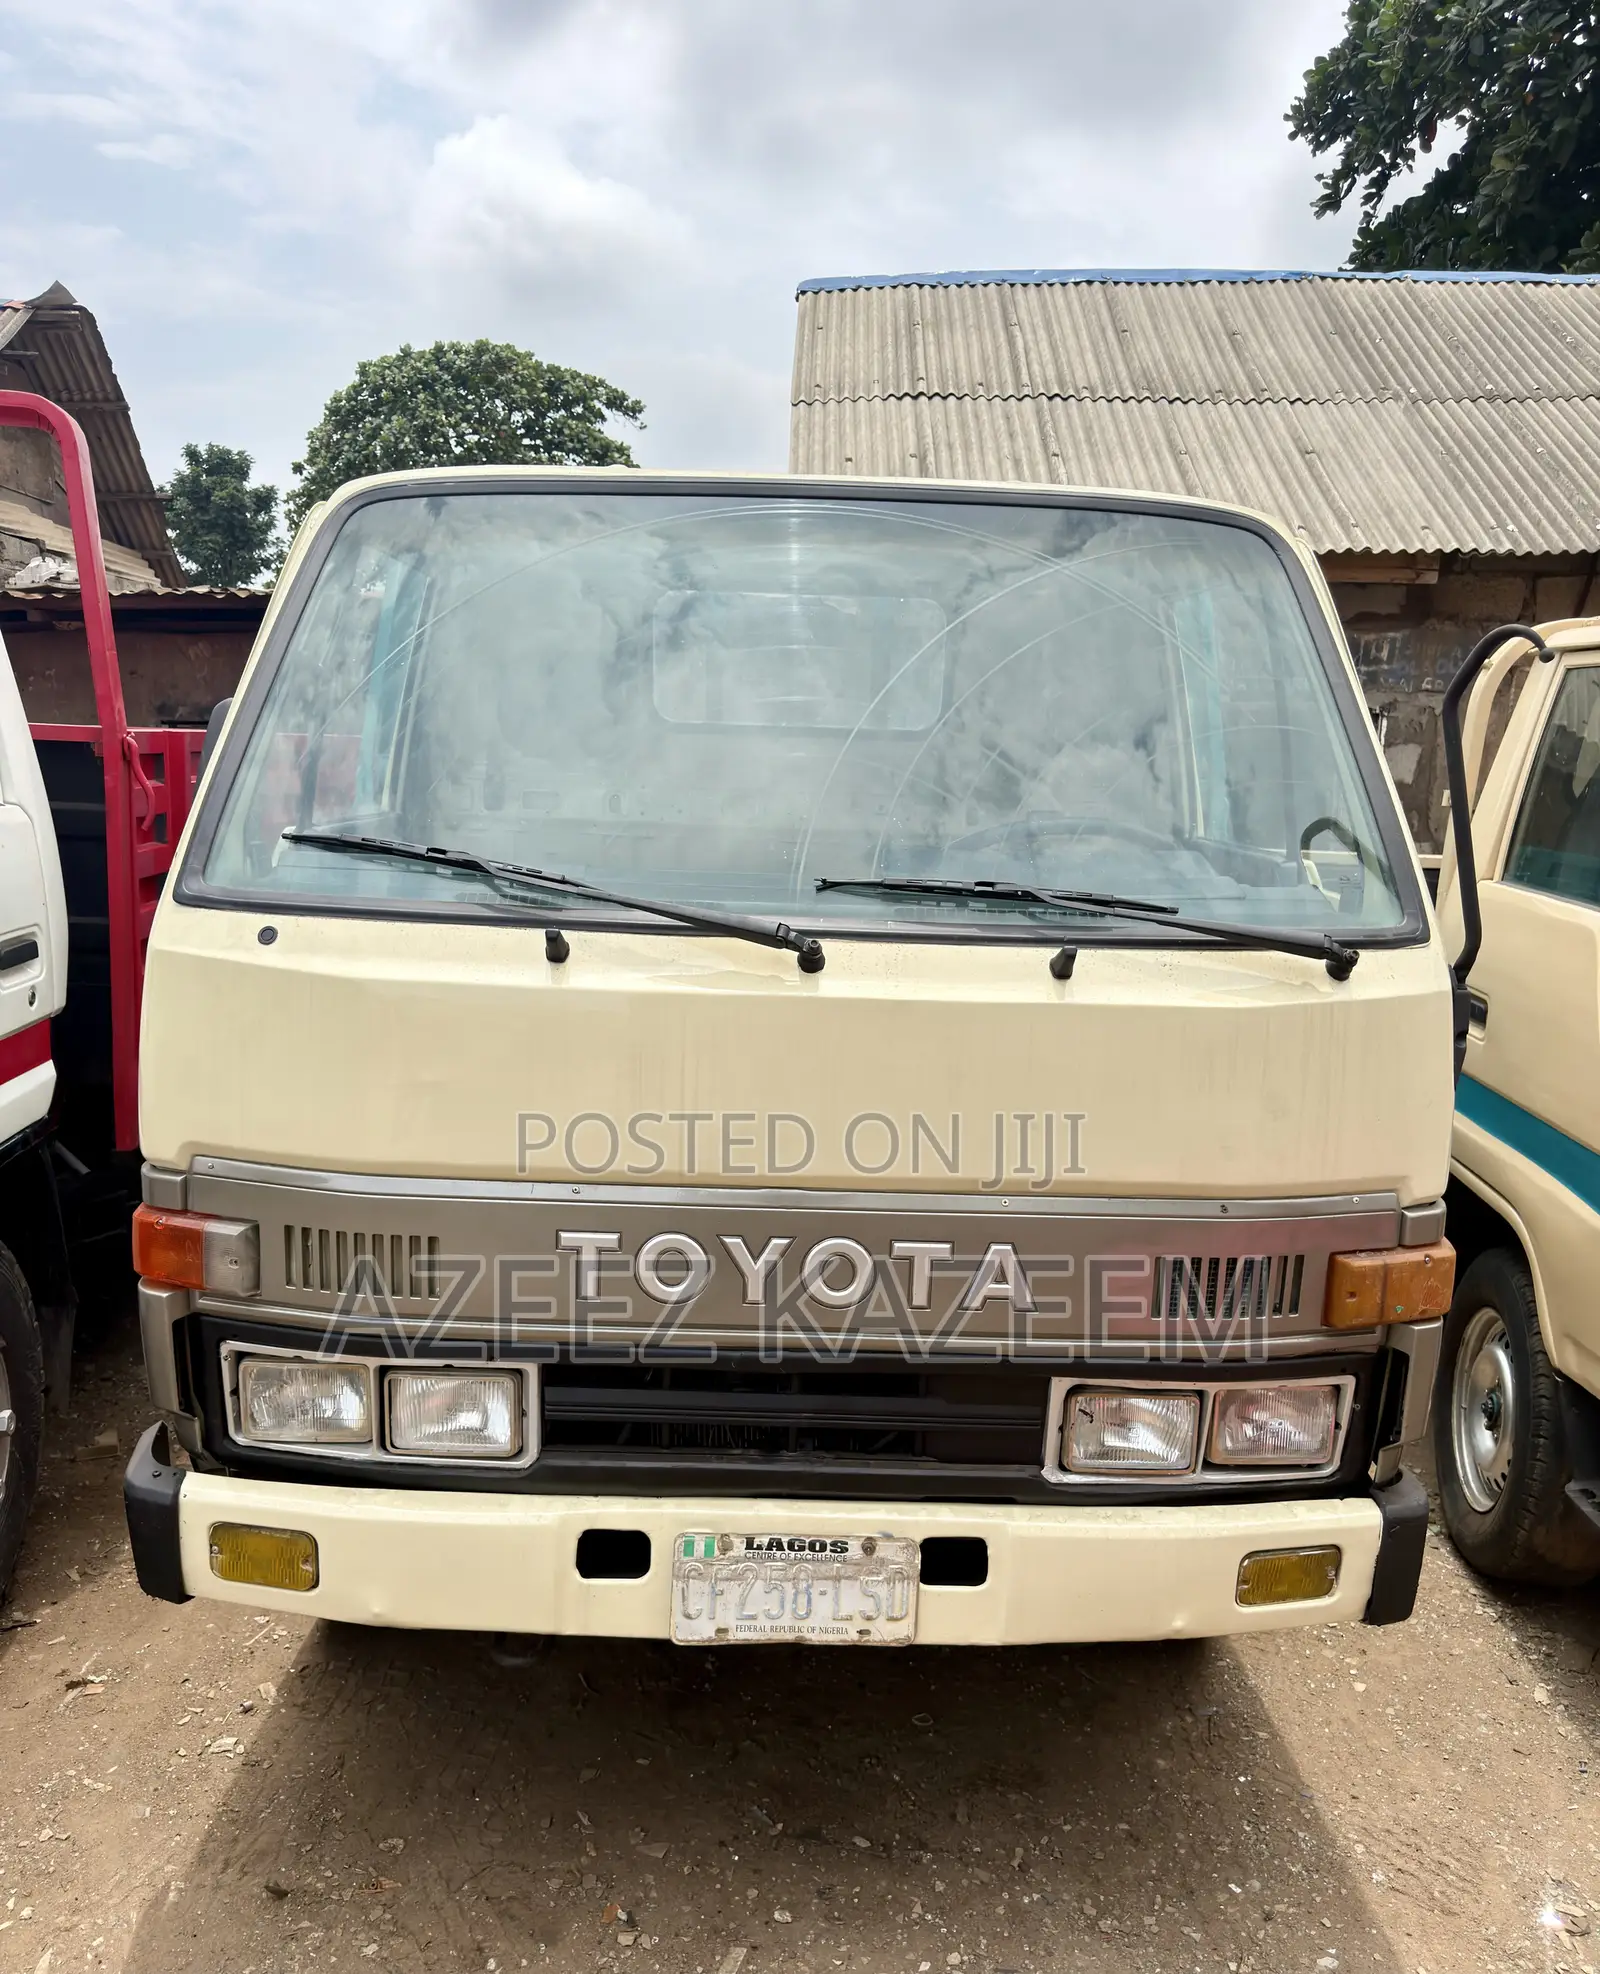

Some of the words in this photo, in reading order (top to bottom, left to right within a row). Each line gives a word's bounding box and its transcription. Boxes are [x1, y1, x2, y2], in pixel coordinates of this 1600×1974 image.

[555, 1228, 1039, 1313] TOYOTA
[744, 1536, 849, 1554] LAGOS
[744, 1551, 778, 1560] CENTRE
[779, 1552, 792, 1561] OF
[793, 1552, 848, 1563] EXCELLENCE
[735, 1624, 767, 1633] FEDERAL
[769, 1625, 804, 1634] REPUBLIC
[806, 1626, 817, 1634] OF
[819, 1626, 849, 1635] NIGERIA
